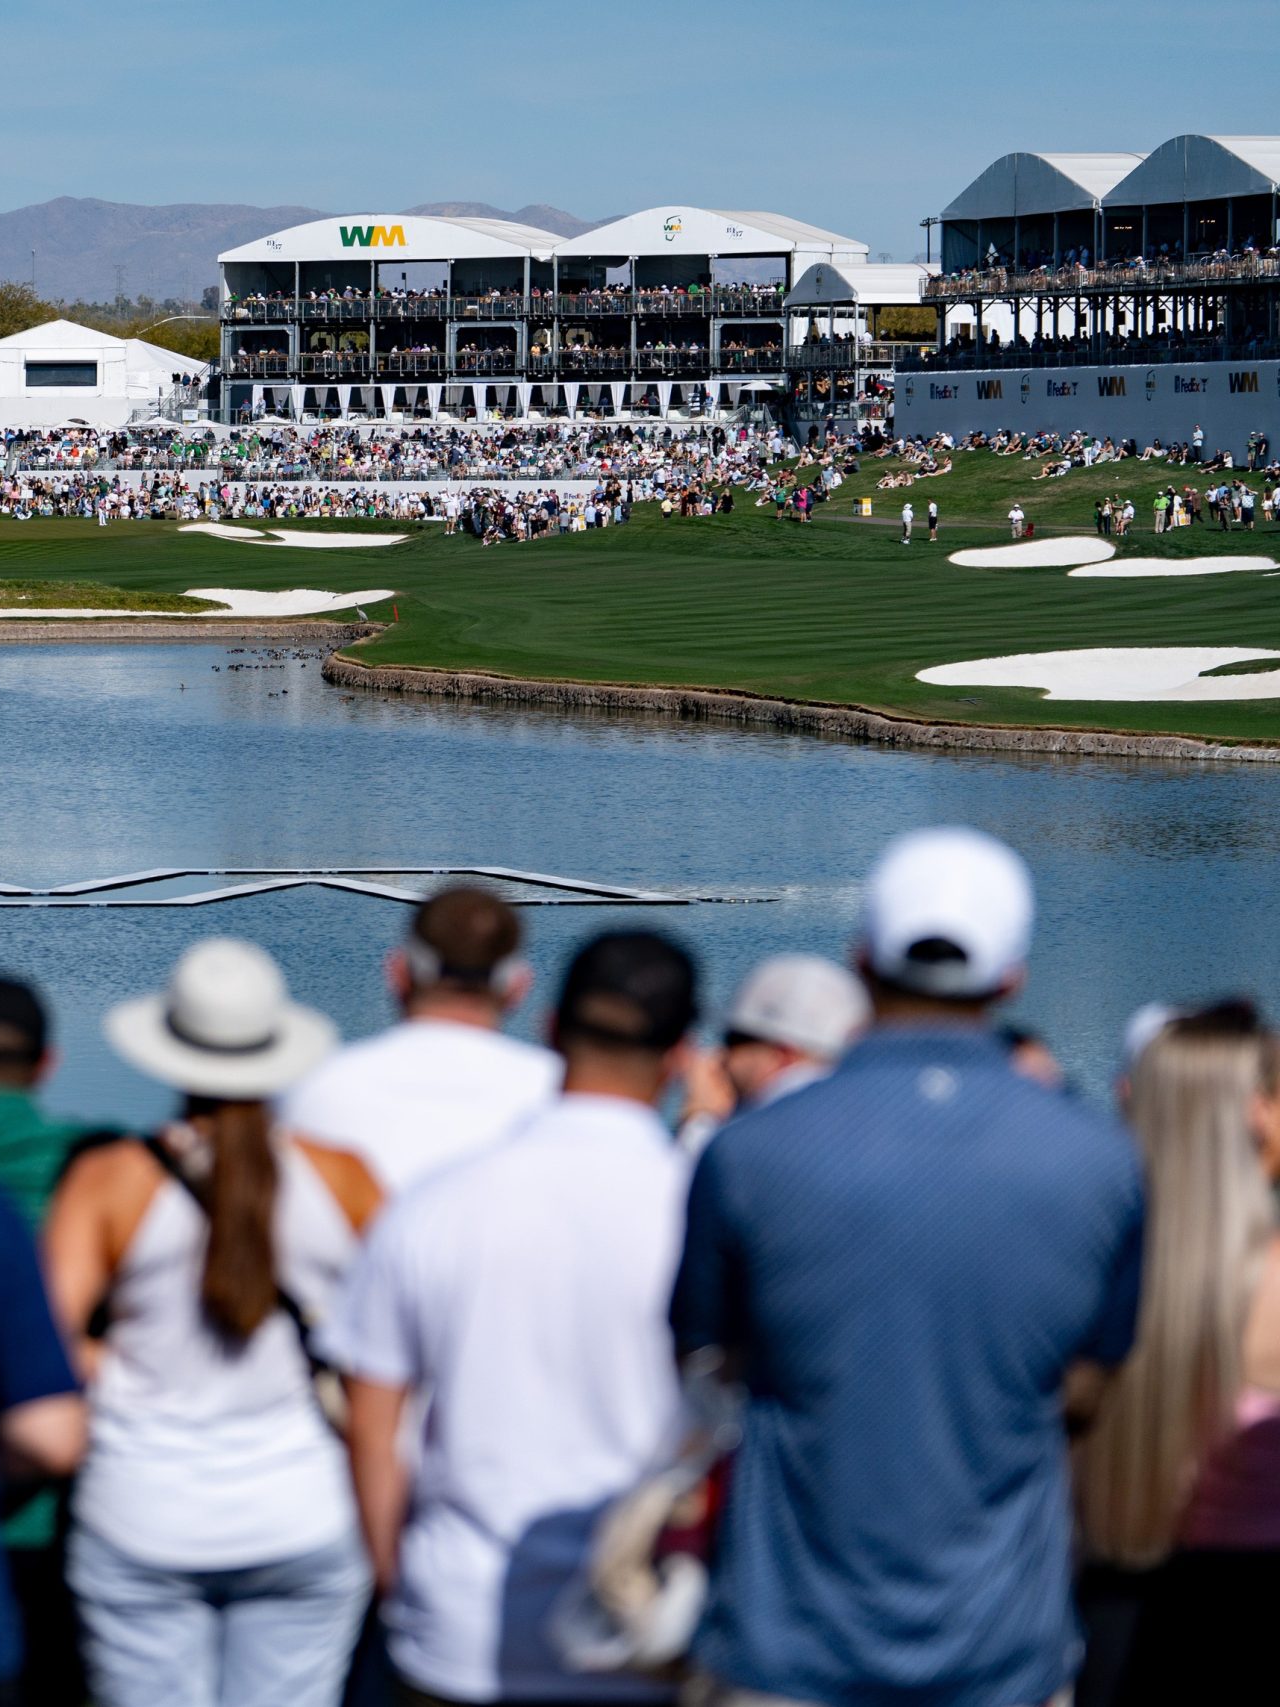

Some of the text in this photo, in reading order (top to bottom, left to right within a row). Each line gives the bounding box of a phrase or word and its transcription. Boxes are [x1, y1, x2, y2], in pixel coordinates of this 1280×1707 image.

[339, 225, 406, 247] WM
[976, 379, 1003, 400] WM
[1097, 375, 1126, 397] WM
[1228, 371, 1259, 394] WM
